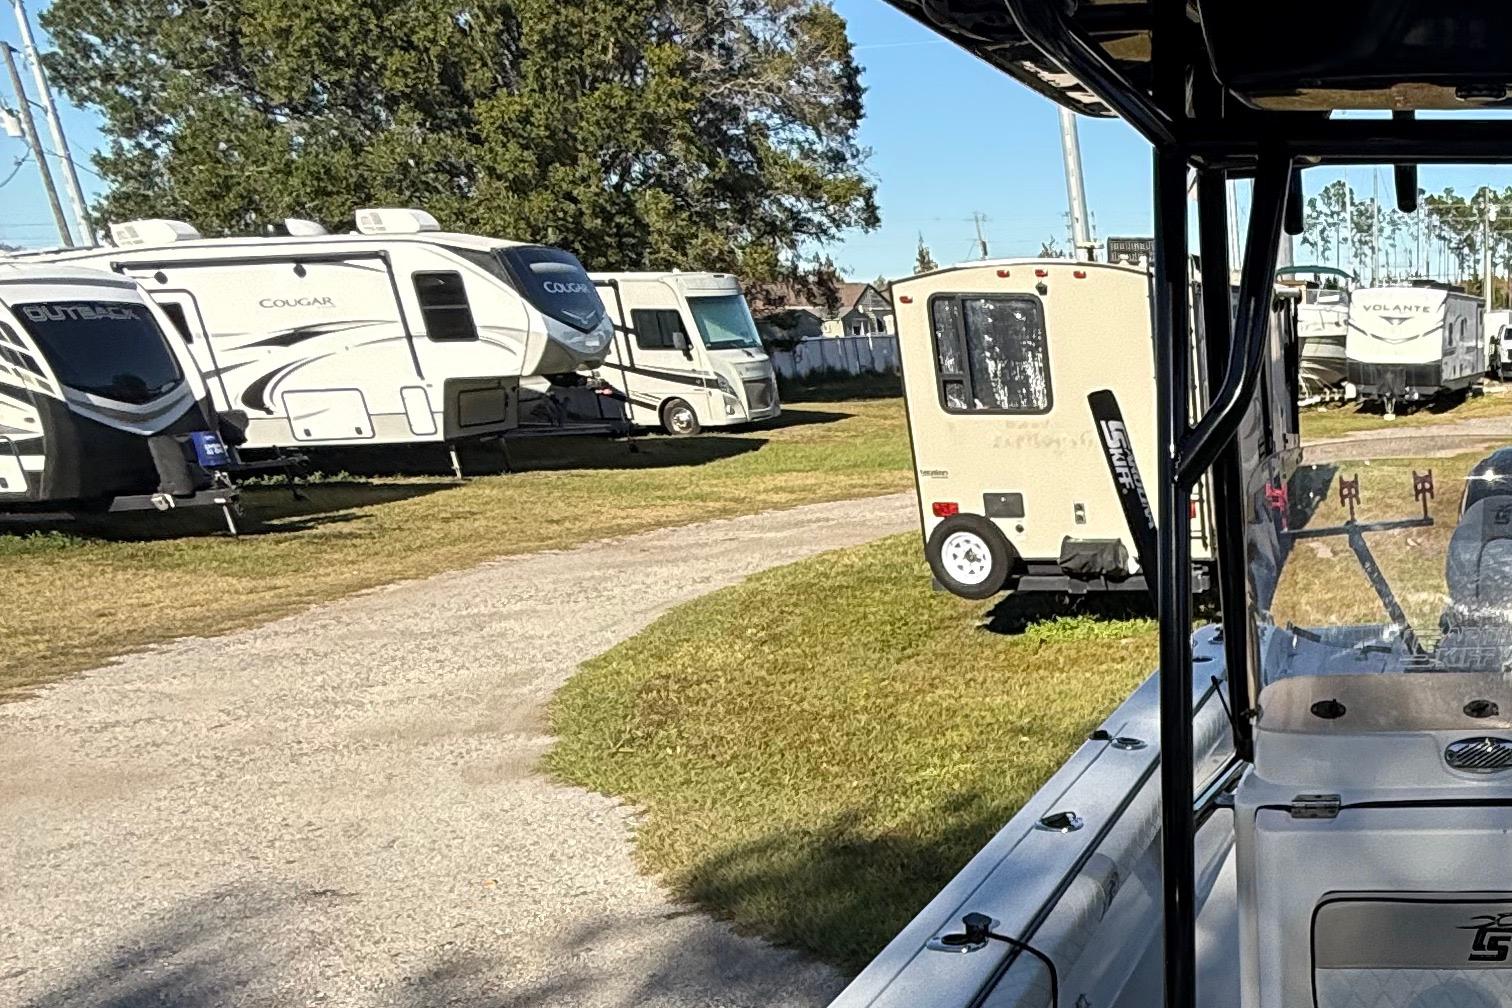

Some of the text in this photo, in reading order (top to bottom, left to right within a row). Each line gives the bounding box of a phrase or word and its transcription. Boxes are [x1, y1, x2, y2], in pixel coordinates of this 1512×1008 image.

[259, 296, 334, 308] COUGAR
[23, 304, 141, 322] OUTBACK
[1363, 304, 1431, 313] VOLANTE
